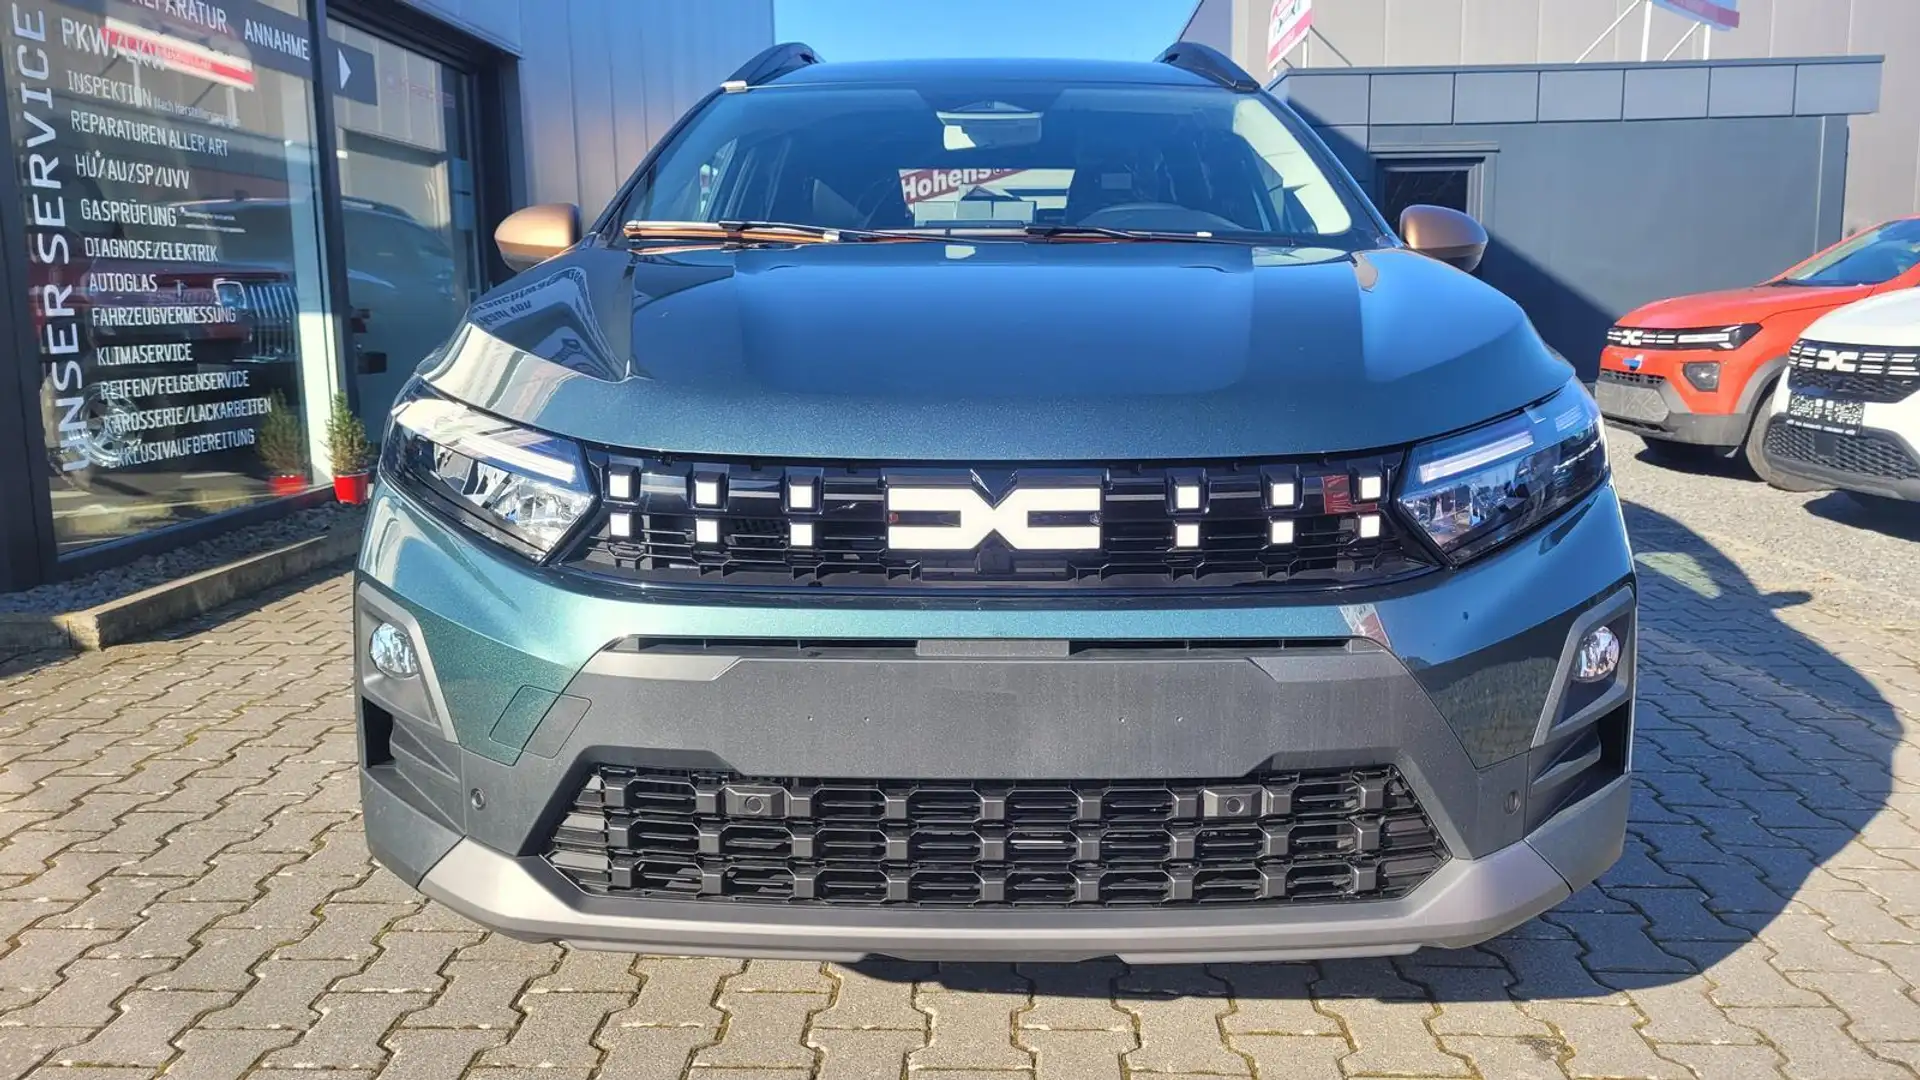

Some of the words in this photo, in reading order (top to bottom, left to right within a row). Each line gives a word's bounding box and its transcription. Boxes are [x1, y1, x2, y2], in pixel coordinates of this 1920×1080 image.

[61, 18, 166, 72] PKW/LKW
[132, 0, 228, 34] ARATUR
[244, 18, 310, 61] ANNAHME
[67, 70, 152, 107] INSPEKTION
[12, 2, 69, 264] SERVICE
[70, 110, 170, 146] REPARATUREN
[168, 130, 208, 153] ALLER
[208, 138, 228, 157] ART
[84, 237, 218, 262] DIAGNOSE/ELEKTRIK
[89, 273, 158, 293] AUTOGLAS
[92, 306, 236, 327] FAHRZEUGVERMESSUNG
[96, 343, 194, 367] KLIMASERVICE
[43, 283, 90, 472] UNSER
[100, 370, 250, 401] REIFEN/FELGENSERVICE
[104, 397, 272, 435] KAROSSERIE/LACKARBEITEN
